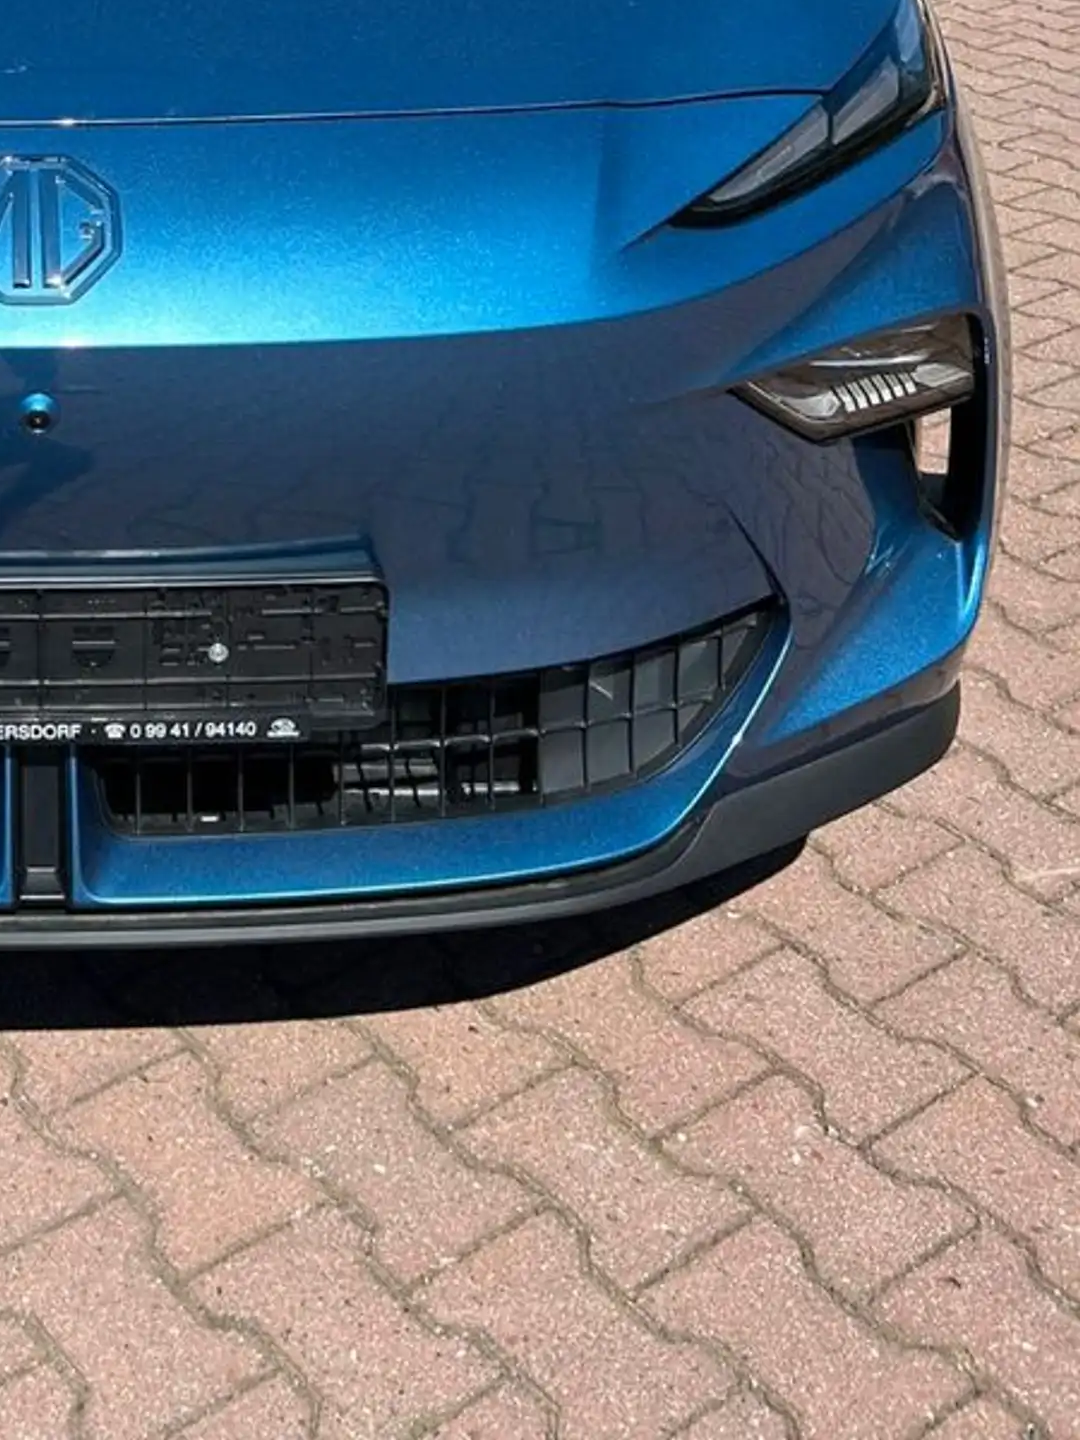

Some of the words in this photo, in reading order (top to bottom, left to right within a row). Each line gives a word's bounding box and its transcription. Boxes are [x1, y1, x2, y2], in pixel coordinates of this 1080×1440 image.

[129, 723, 141, 739] 0
[144, 723, 166, 739] 99
[169, 722, 190, 738] 41
[204, 720, 257, 738] 94140
